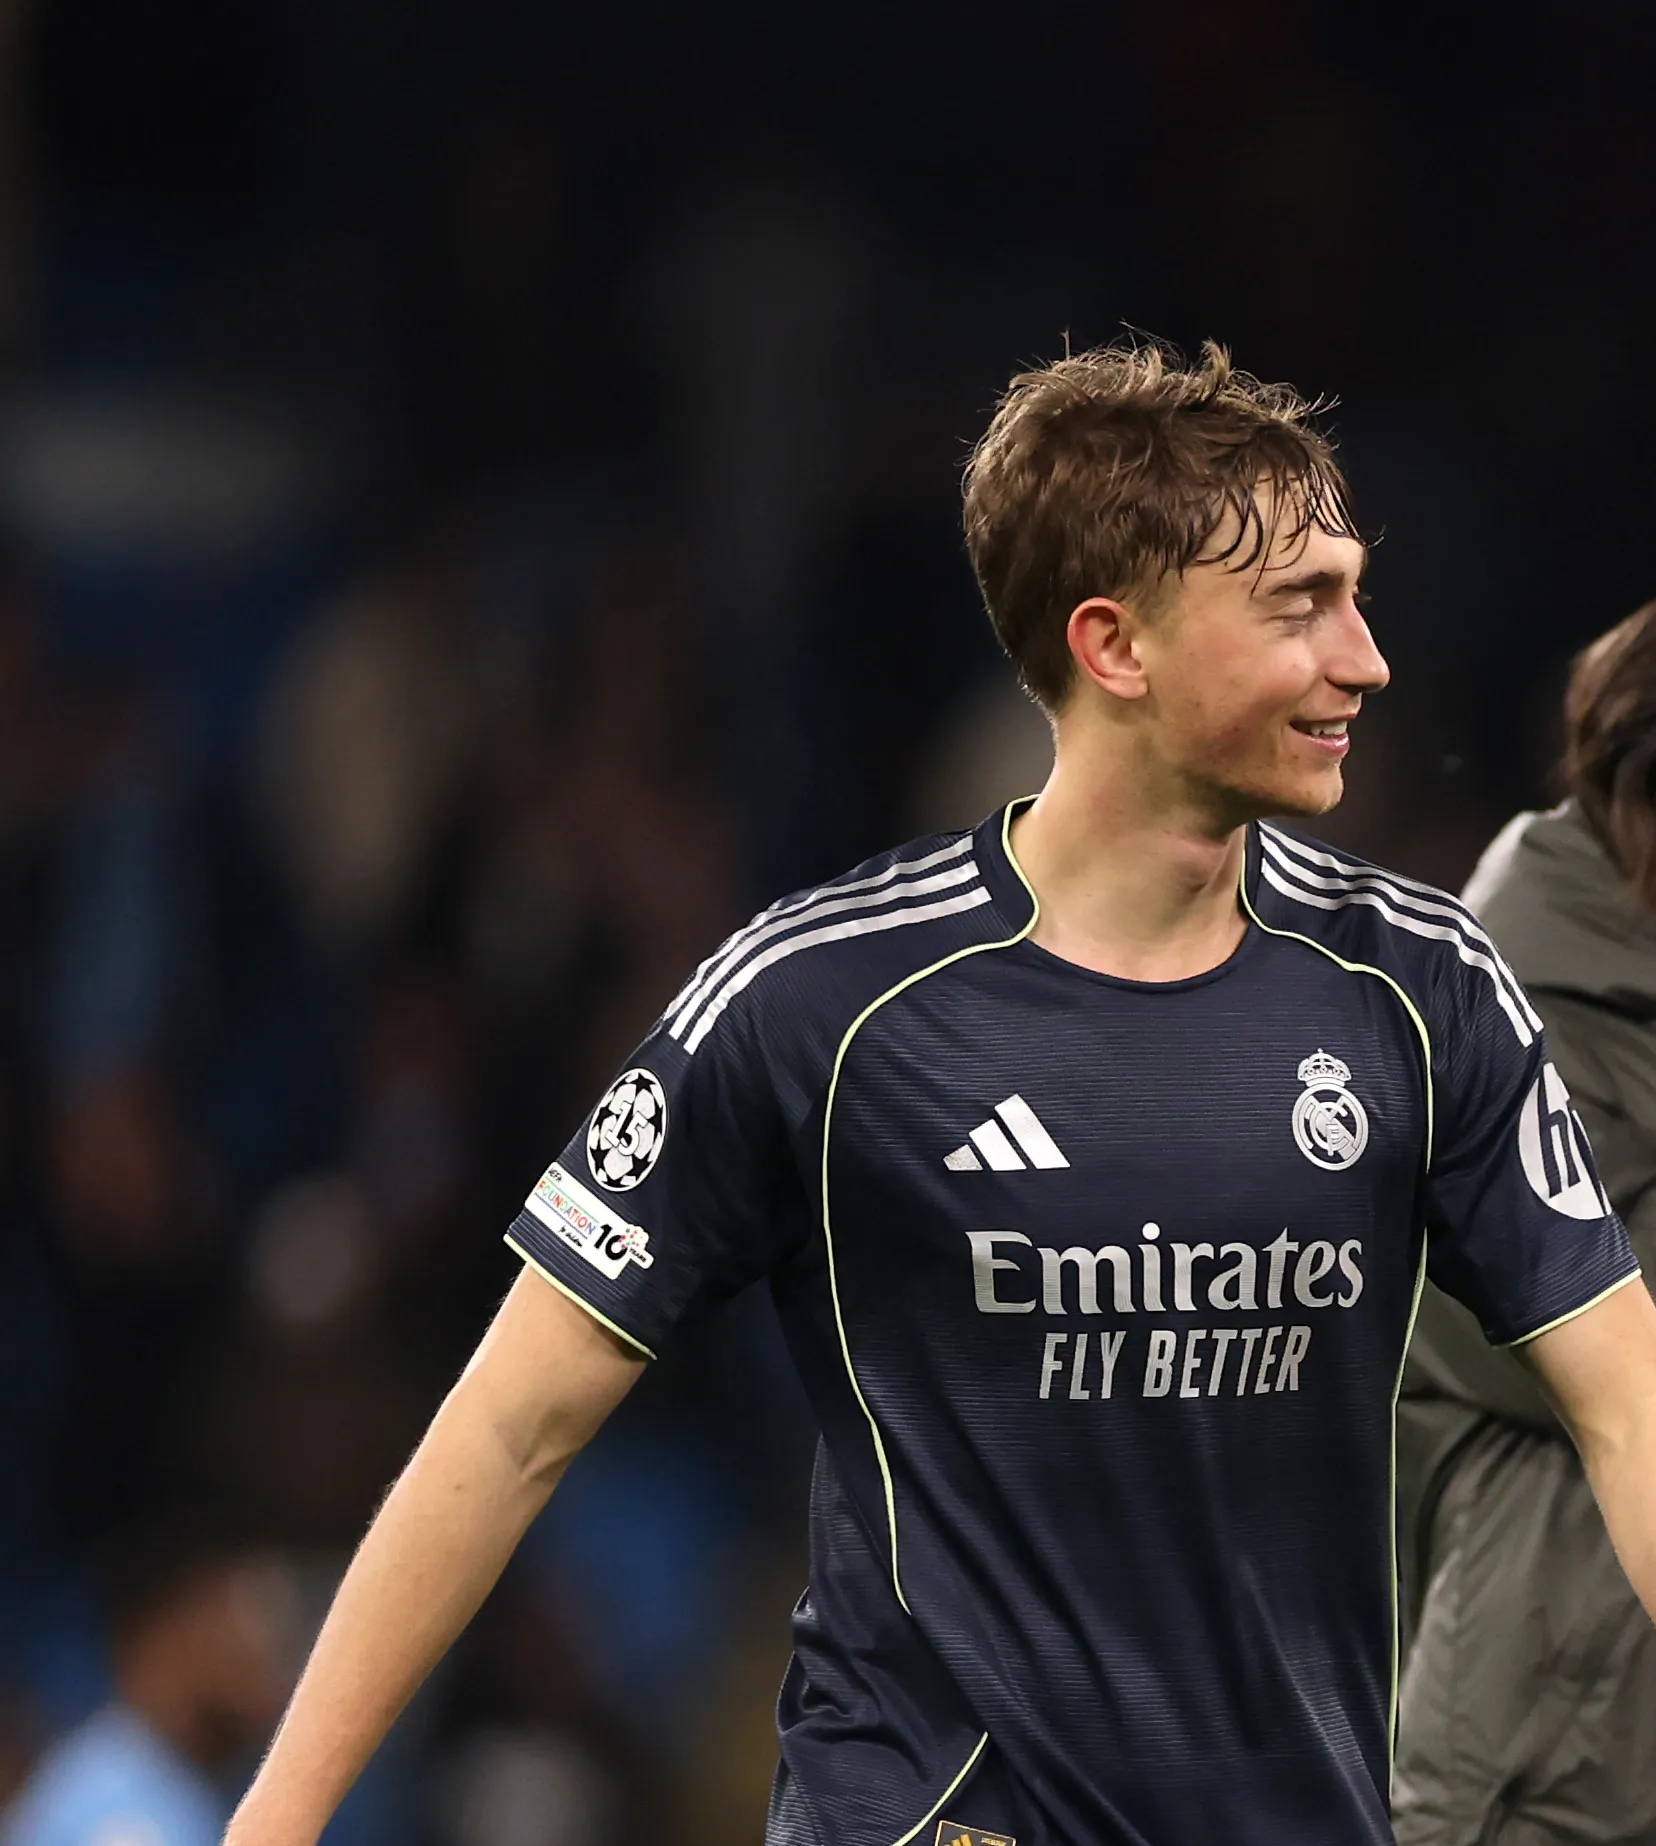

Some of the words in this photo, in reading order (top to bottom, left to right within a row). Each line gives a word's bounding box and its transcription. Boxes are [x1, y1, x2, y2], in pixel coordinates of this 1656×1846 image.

[605, 1100, 649, 1156] 15
[536, 1180, 598, 1236] FOUNDATION
[594, 1224, 629, 1261] 10
[965, 1222, 1364, 1315] Emirates
[1039, 1331, 1127, 1400] FLY
[1142, 1325, 1312, 1398] BETTER
